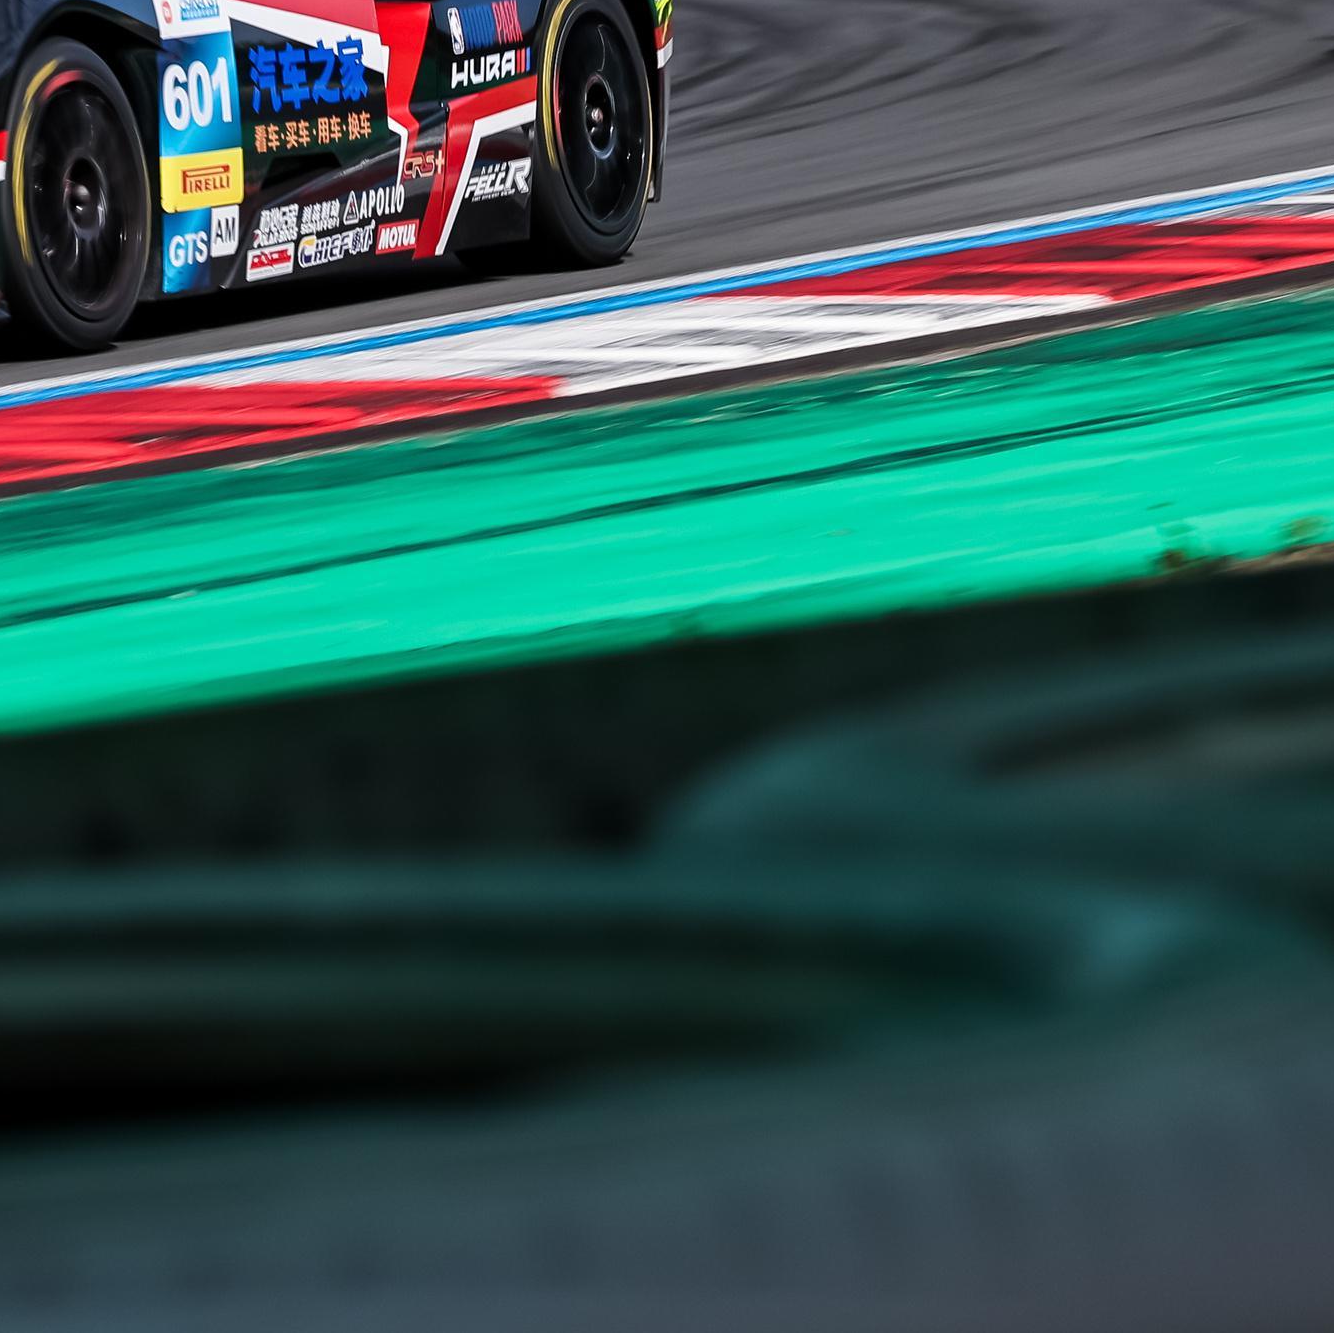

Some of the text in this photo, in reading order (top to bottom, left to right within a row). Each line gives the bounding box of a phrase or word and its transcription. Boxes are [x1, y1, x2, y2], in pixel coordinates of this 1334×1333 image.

[491, 0, 523, 45] PARK
[248, 35, 368, 113] 汽车之家
[162, 57, 232, 131] 601
[181, 164, 231, 195] PIRELLI
[359, 185, 405, 218] APOLLO
[169, 230, 208, 267] GTS
[214, 217, 236, 245] AM
[378, 223, 417, 250] MOTUL
